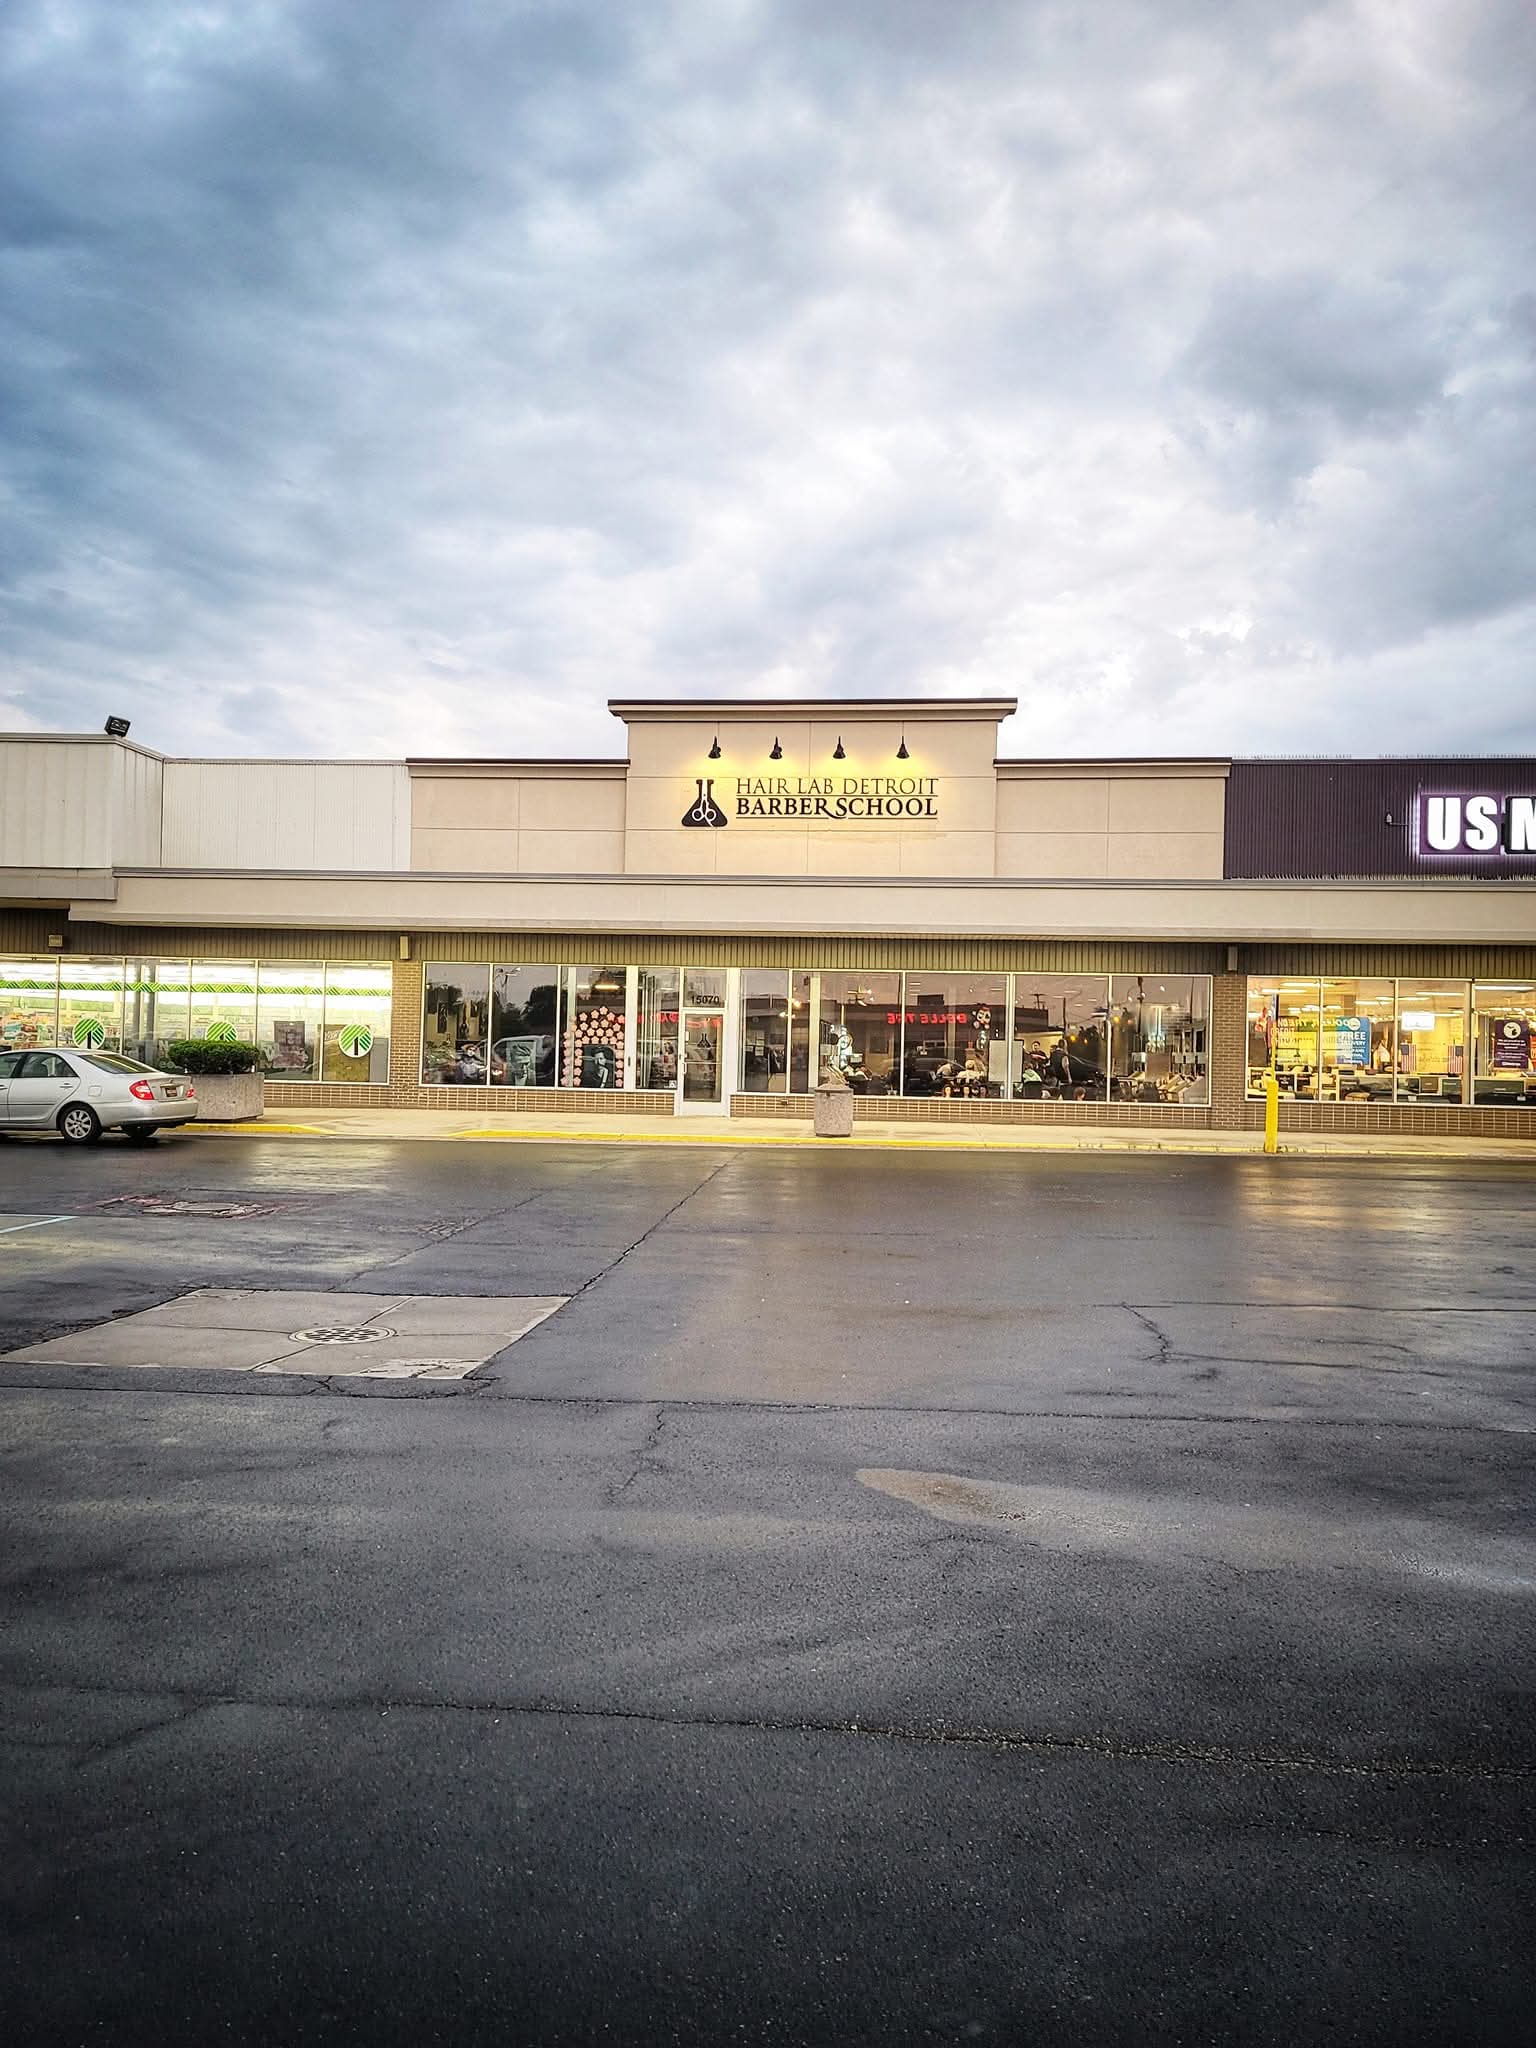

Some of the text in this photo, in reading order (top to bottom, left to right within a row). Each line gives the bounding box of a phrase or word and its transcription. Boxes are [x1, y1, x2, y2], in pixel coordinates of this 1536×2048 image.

[736, 778, 939, 795] HAIR LAB DETROIT
[736, 797, 938, 819] BARBER SCHOOL
[690, 995, 720, 1005] 15070
